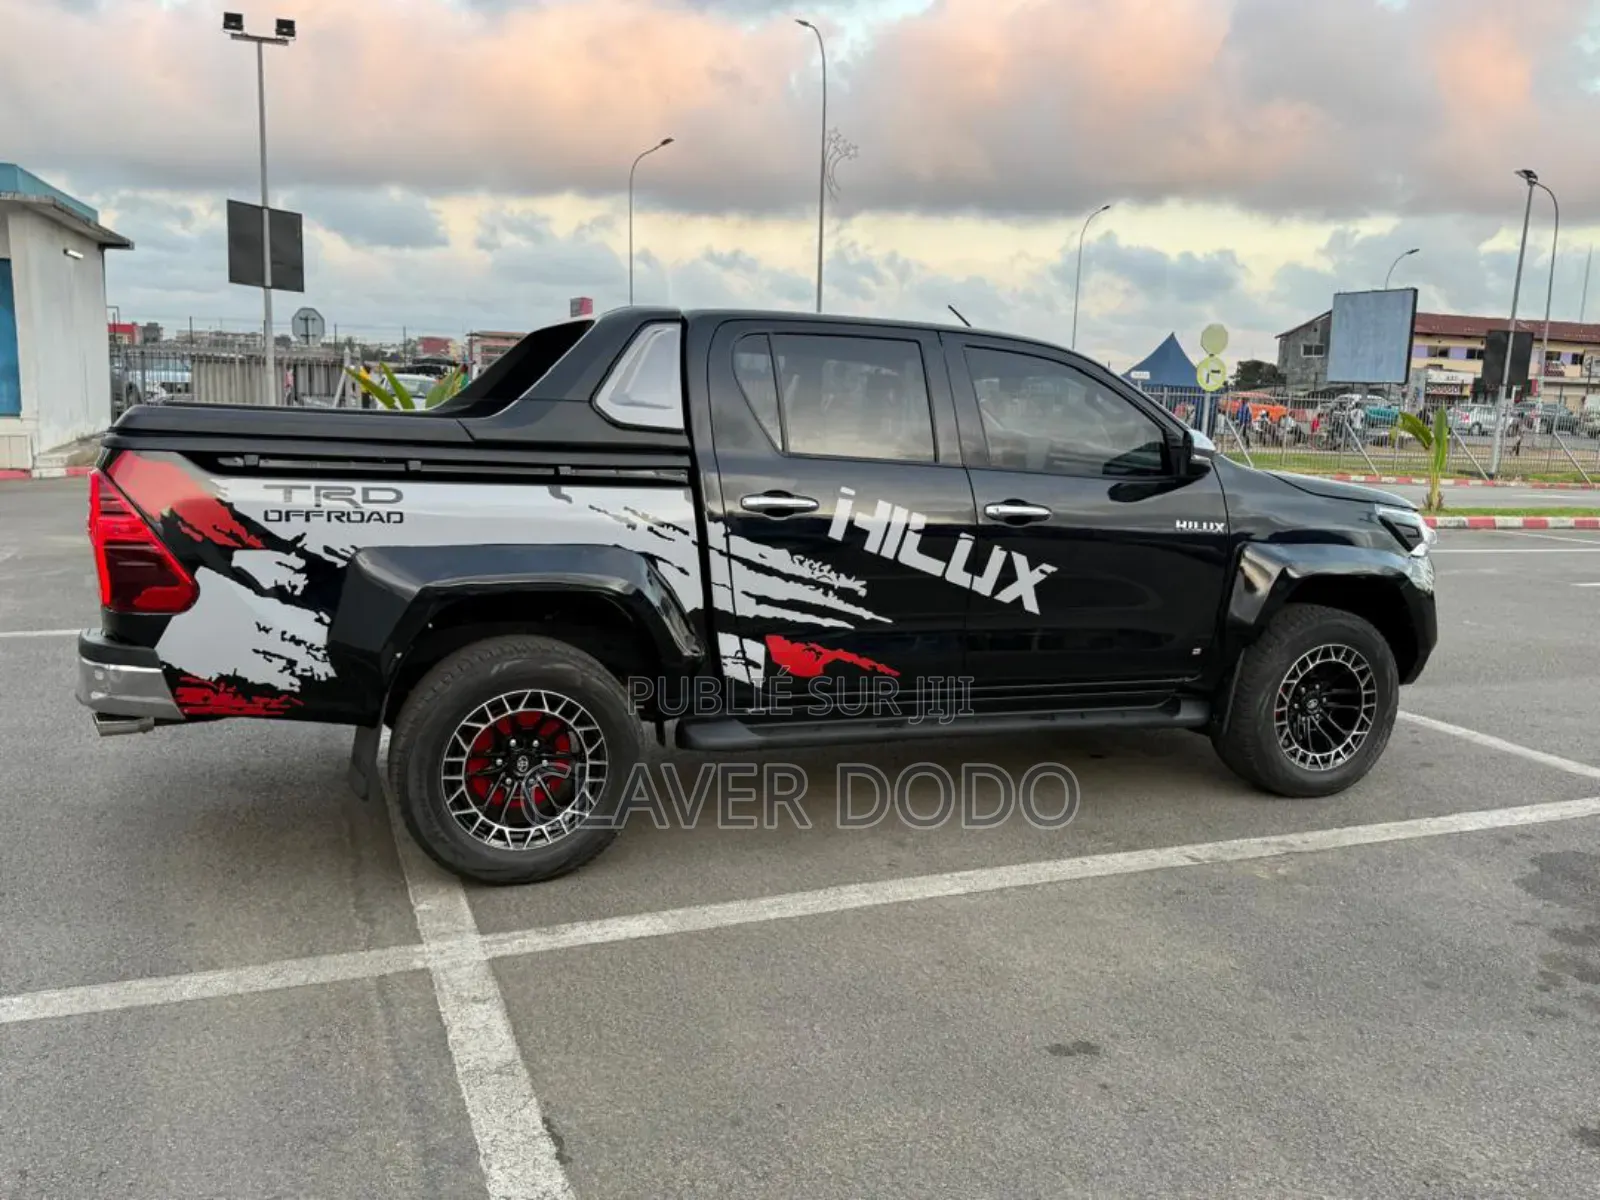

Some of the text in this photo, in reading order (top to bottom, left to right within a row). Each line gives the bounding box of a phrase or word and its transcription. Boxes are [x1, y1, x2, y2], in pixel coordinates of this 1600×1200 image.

[263, 484, 404, 508] TRD
[263, 509, 404, 524] OFFROAD
[1175, 519, 1225, 533] HILUX
